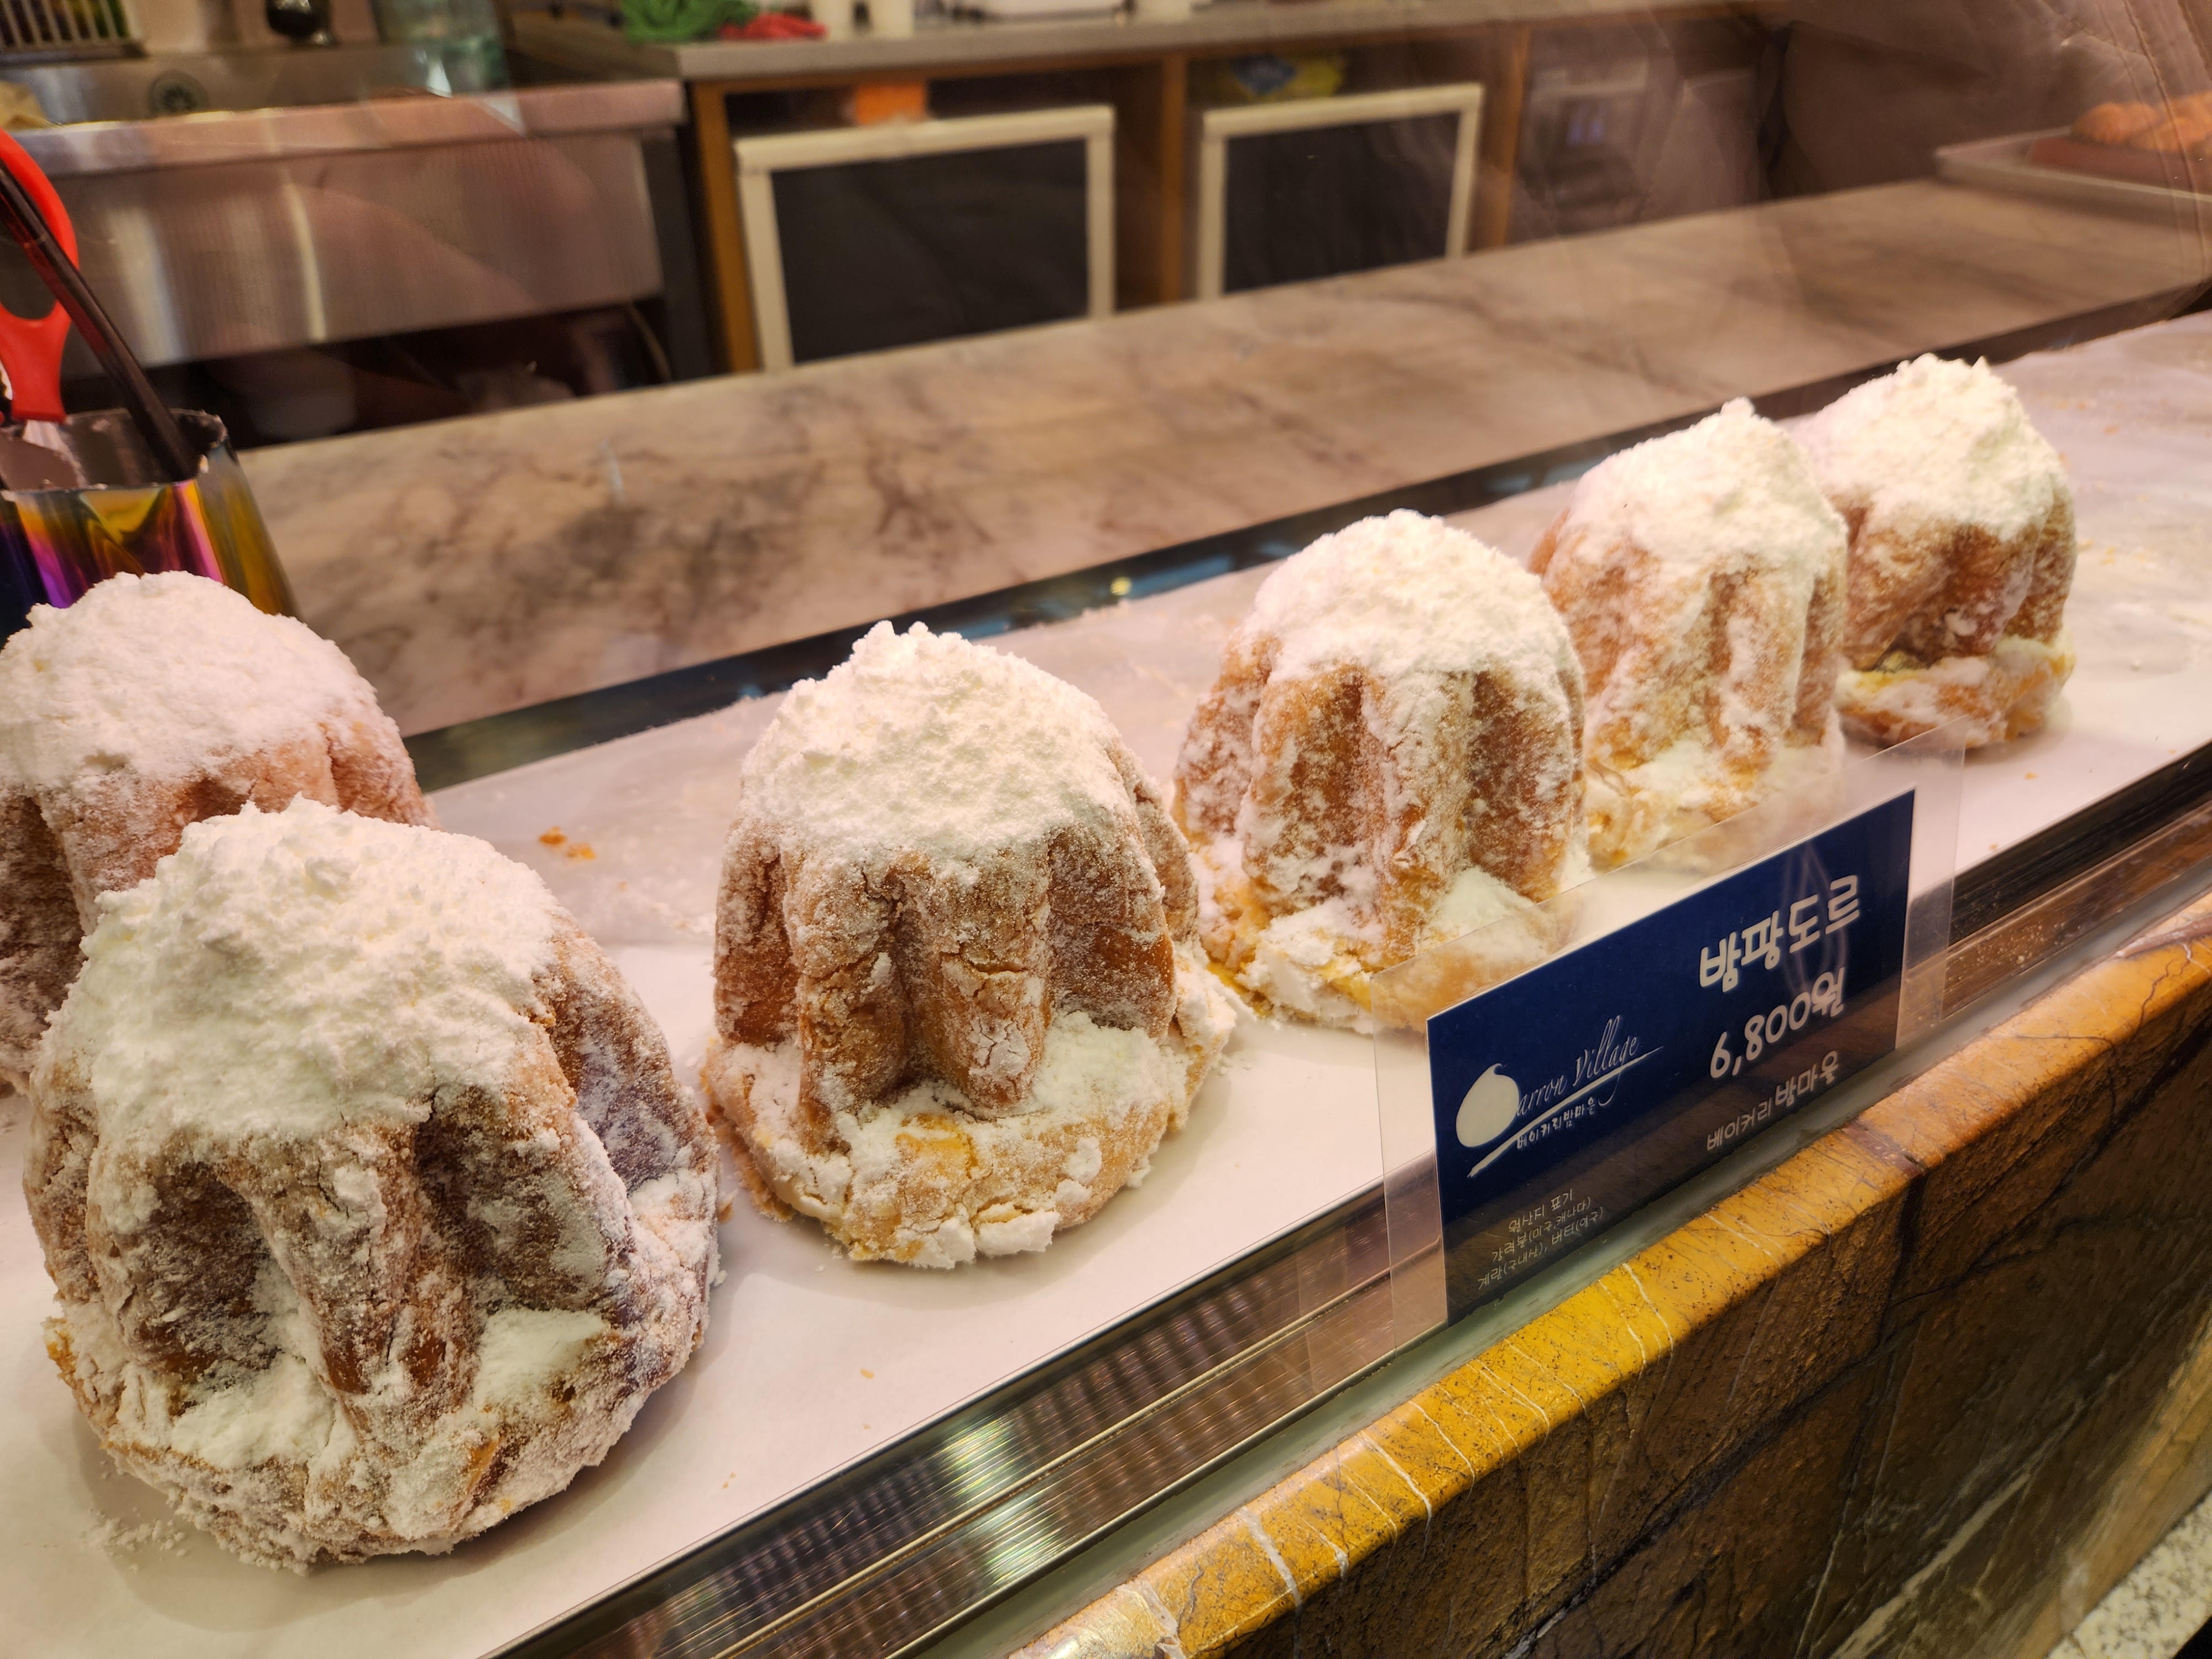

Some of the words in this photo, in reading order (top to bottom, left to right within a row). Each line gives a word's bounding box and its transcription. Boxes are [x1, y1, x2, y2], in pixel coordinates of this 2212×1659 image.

[1699, 875, 1860, 993] 밤팡도르
[1573, 1014, 1637, 1106] Village
[1710, 967, 1845, 1078] 6,800원
[1707, 1097, 1772, 1151] 베이커리
[1774, 1050, 1839, 1107] 밤마을
[1508, 1204, 1545, 1233] 원산지
[1550, 1188, 1573, 1211] 표기
